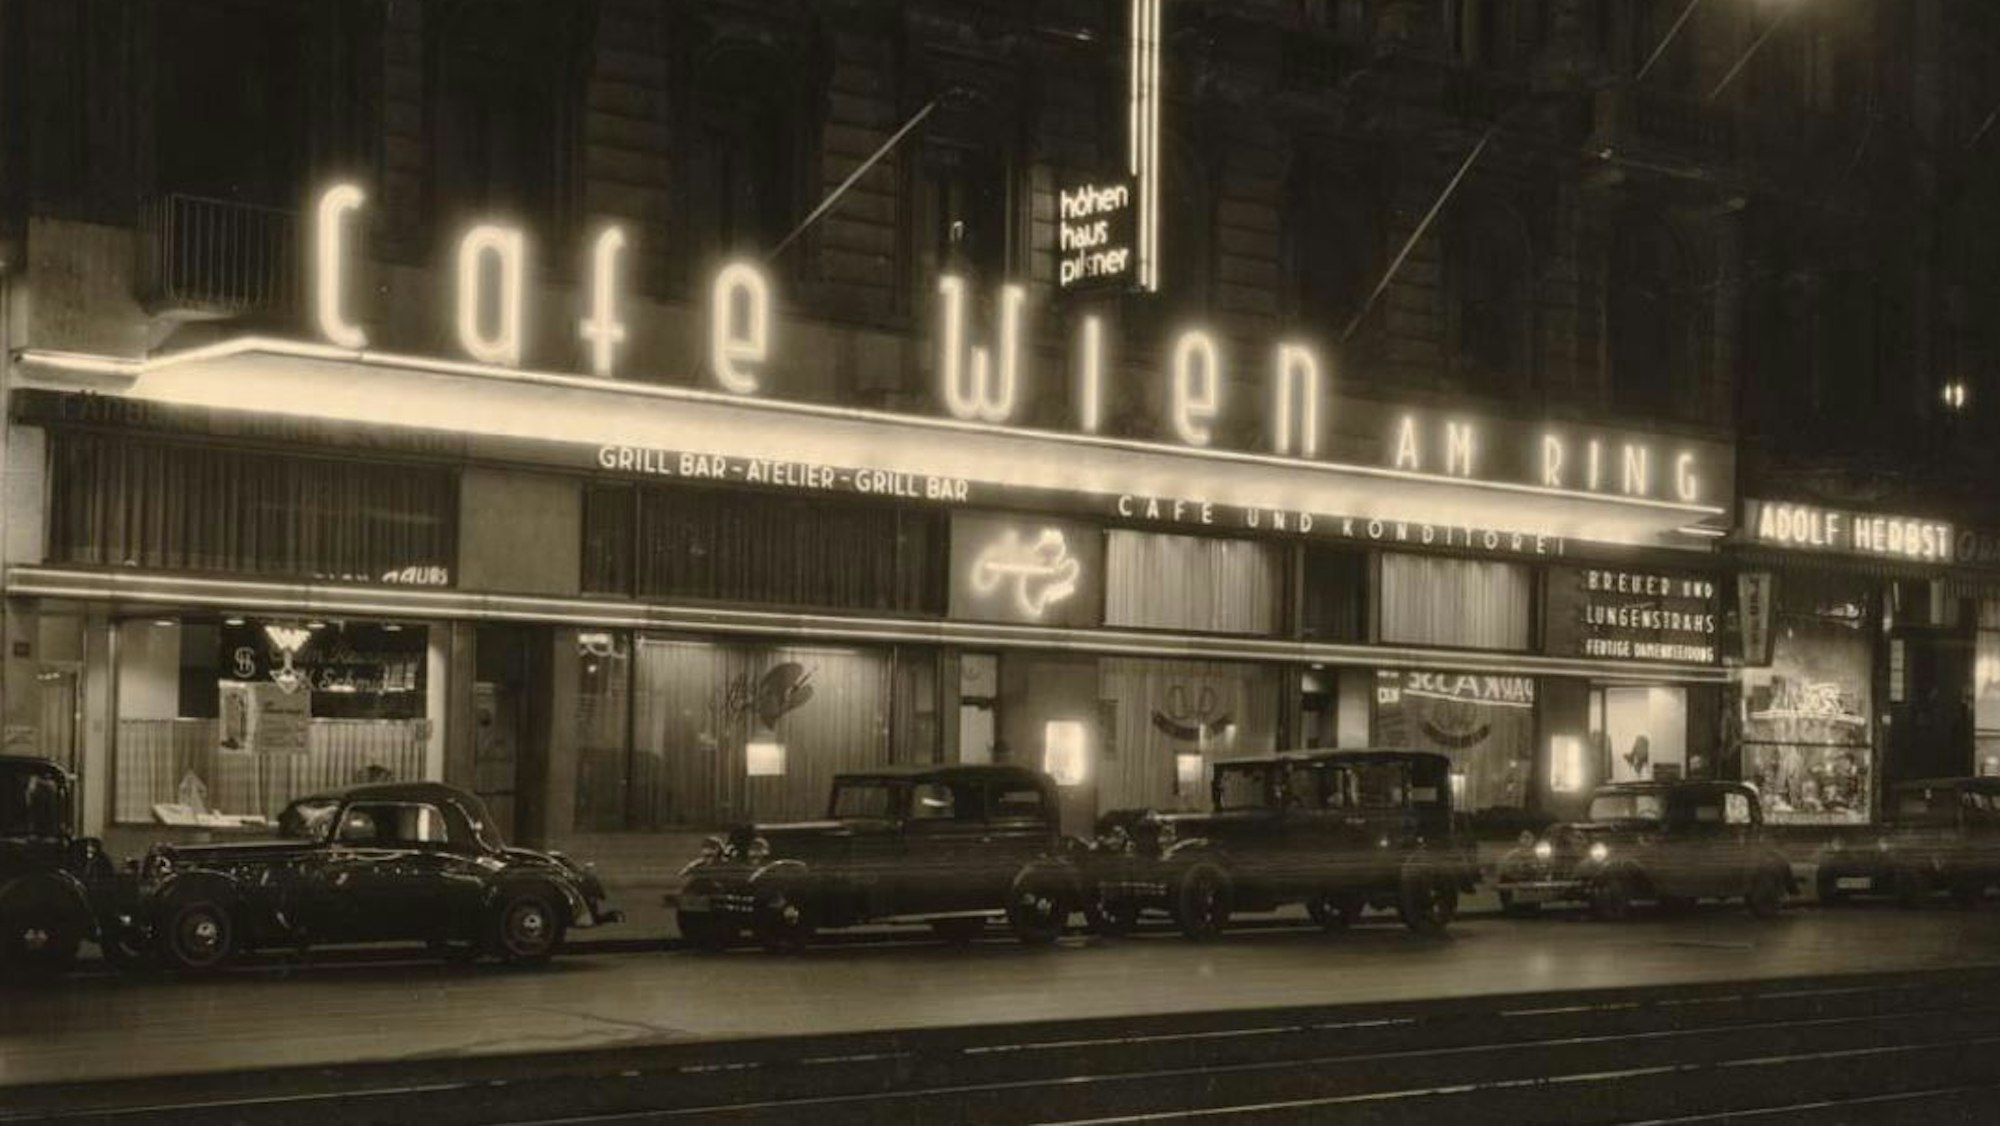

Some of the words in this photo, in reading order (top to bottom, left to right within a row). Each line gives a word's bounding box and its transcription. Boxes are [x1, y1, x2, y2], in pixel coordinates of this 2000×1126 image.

[1061, 220, 1108, 251] haus
[318, 184, 768, 393] Cafe
[940, 275, 1318, 457] Wien
[1396, 415, 1472, 476] AM
[1544, 433, 1697, 501] RING
[599, 447, 672, 475] GRILL
[679, 451, 726, 479] BAR
[746, 458, 835, 489] ATELIER
[854, 468, 920, 498] GRILL
[926, 475, 969, 502] BAR
[1247, 507, 1314, 533] UND
[1342, 517, 1564, 556] KONDITOREI
[1759, 503, 1840, 546] ADOLF
[1854, 516, 1948, 558] HERBST
[1588, 569, 1671, 597] BREUER
[1683, 580, 1713, 600] UND
